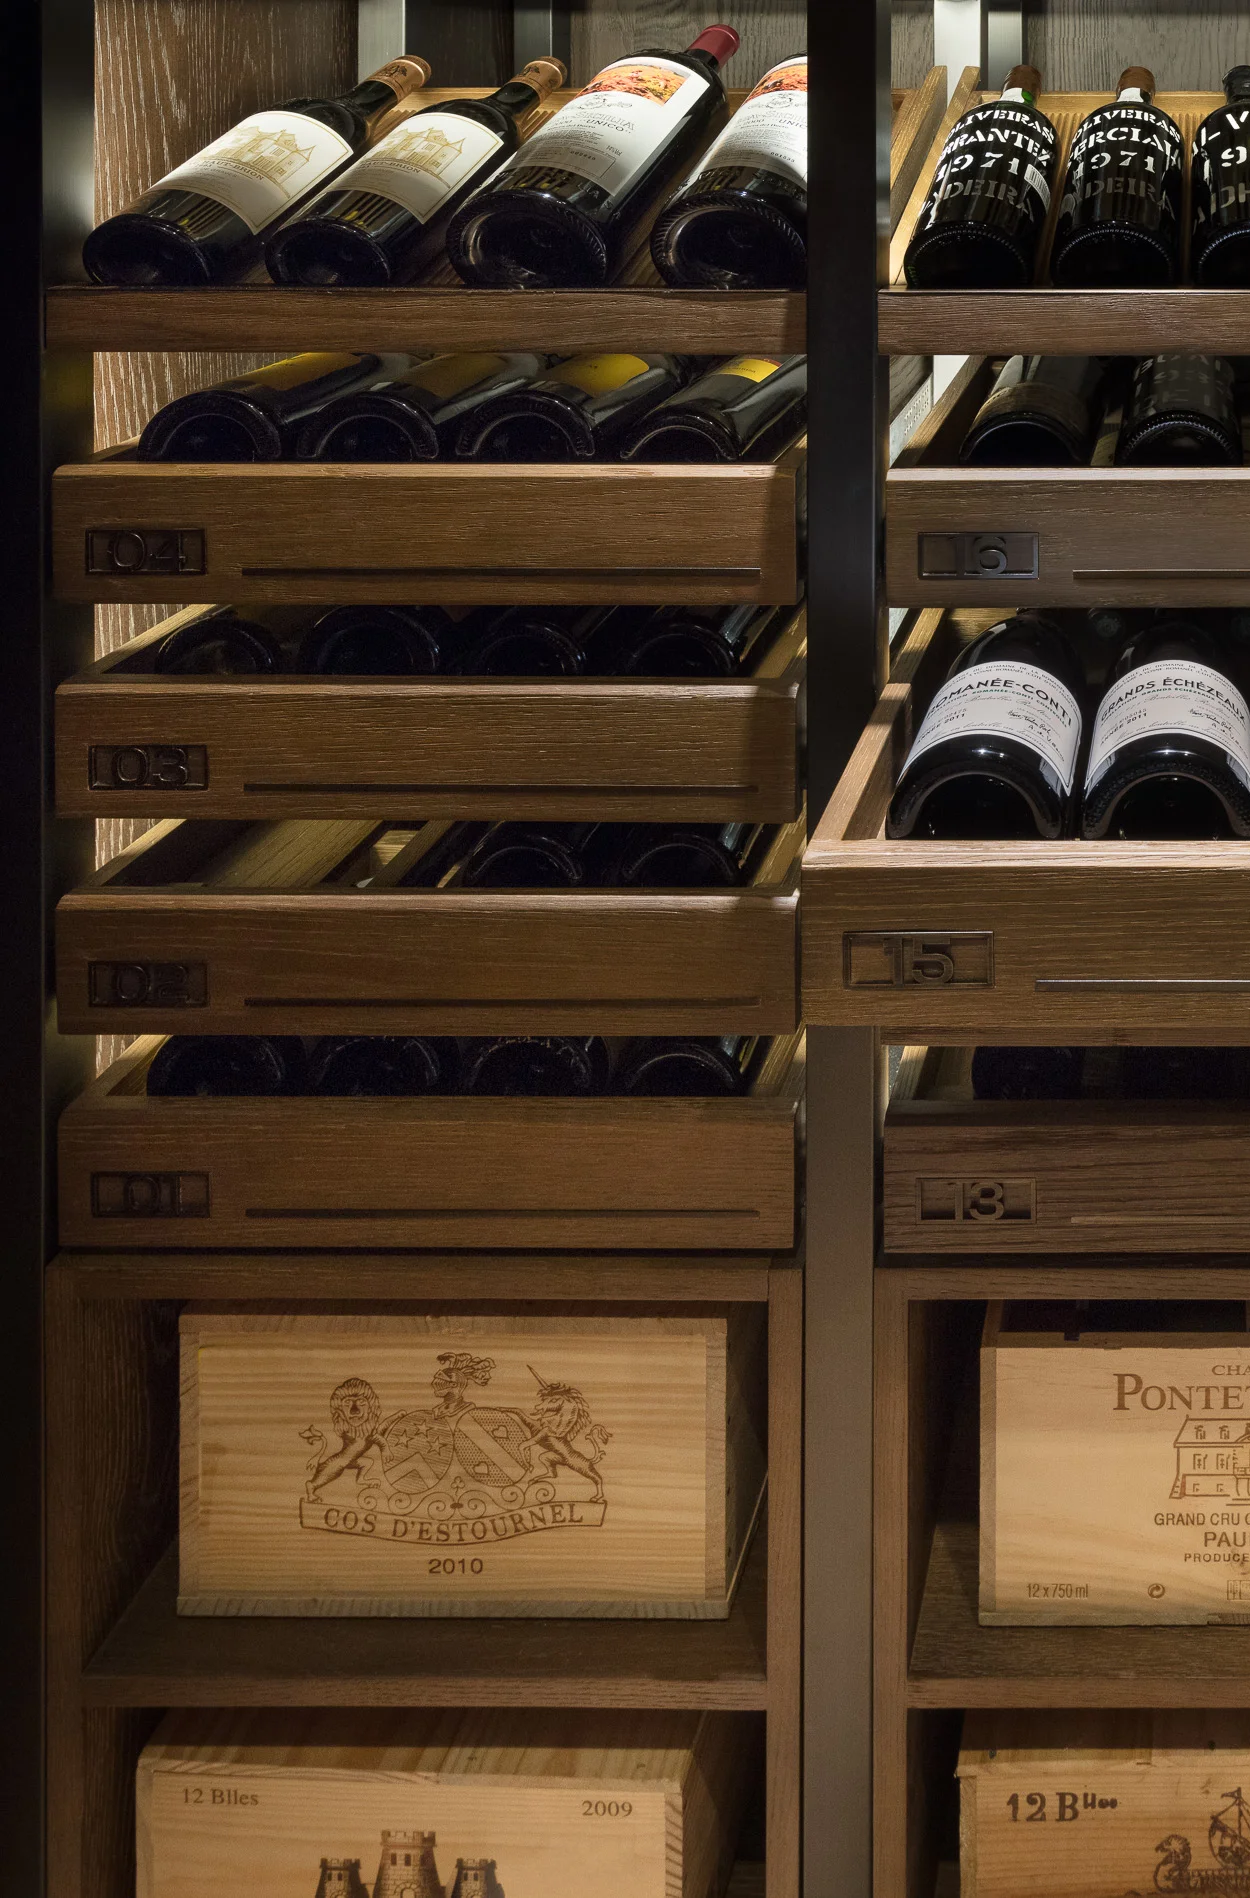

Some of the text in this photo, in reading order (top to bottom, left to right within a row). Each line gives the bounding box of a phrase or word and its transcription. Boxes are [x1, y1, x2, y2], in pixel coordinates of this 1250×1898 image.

[947, 109, 1055, 144] OLIVEIRAS
[1072, 108, 1181, 144] OLIVEIRAS
[935, 151, 1020, 182] 1971
[108, 530, 188, 573] 04
[947, 534, 1009, 576] 16
[944, 713, 966, 724] 2011
[1126, 712, 1147, 725] 2011
[111, 747, 190, 787] 03
[882, 936, 955, 985] 15
[946, 1181, 1005, 1220] 13
[323, 1502, 584, 1543] COS D'ESTOURNEL
[1153, 1512, 1206, 1526] GRAND
[1210, 1512, 1241, 1526] CRU
[427, 1558, 484, 1576] 2010
[1183, 1552, 1250, 1563] PRODUCE
[1026, 1583, 1040, 1599] 12
[1051, 1583, 1073, 1599] 750
[1075, 1583, 1089, 1599] ml
[182, 1788, 260, 1808] 12 Blles
[581, 1800, 634, 1818] 2009
[1006, 1791, 1047, 1823] 12
